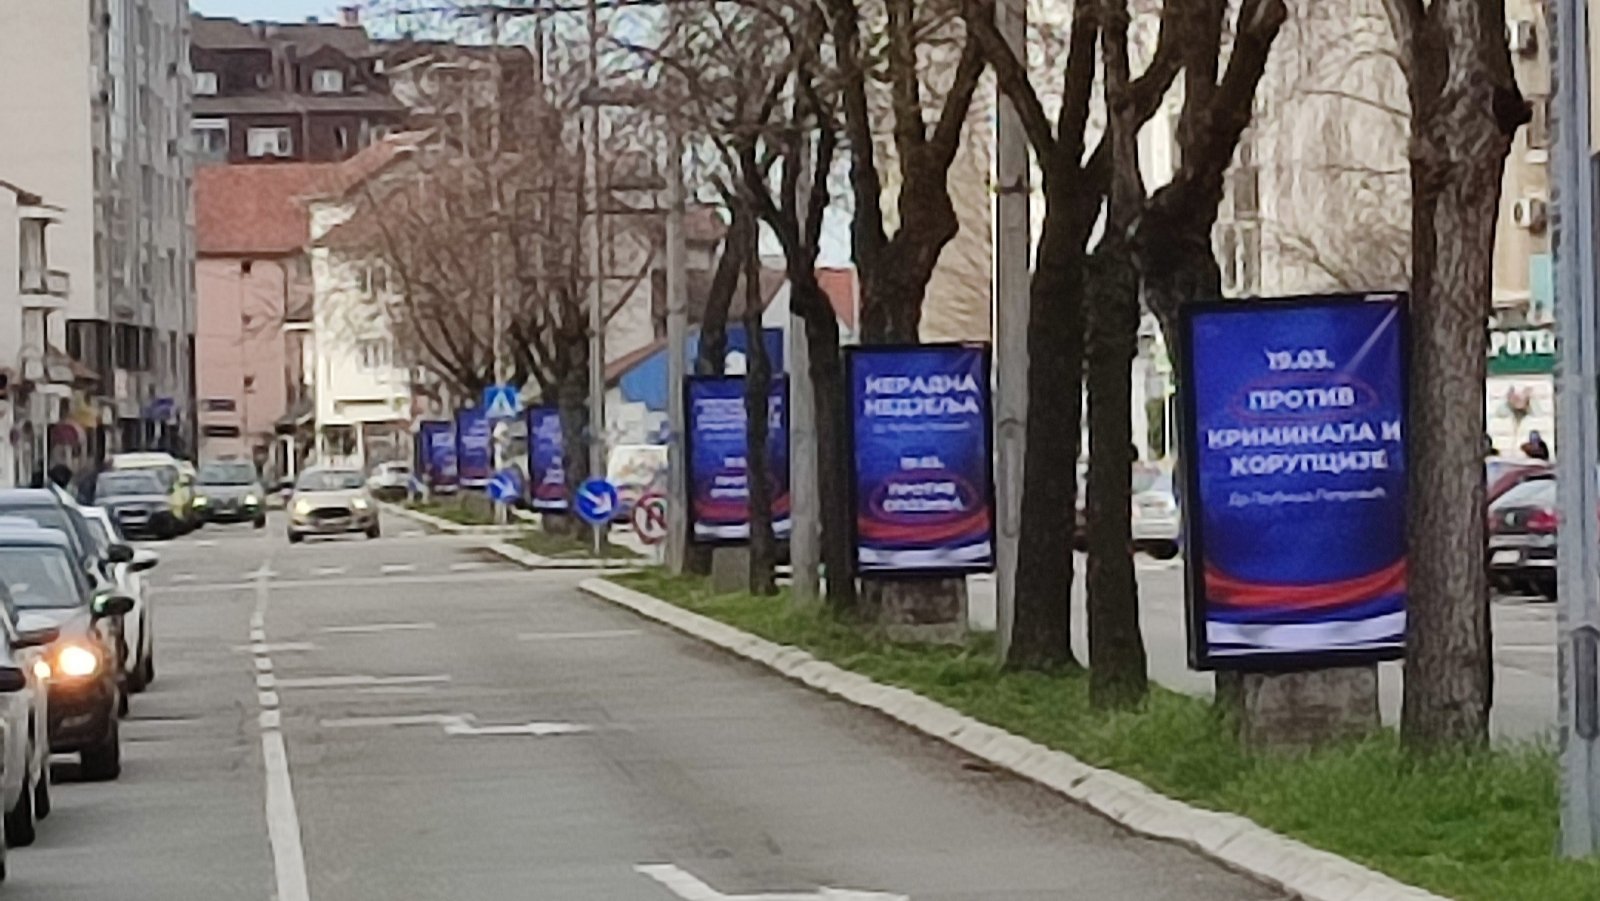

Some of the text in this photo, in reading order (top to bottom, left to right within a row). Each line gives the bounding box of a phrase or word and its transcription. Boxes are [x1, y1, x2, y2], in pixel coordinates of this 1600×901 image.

[1267, 349, 1335, 369] 19.03.
[865, 374, 978, 394] НЕРАДНА
[1249, 386, 1355, 410] ПРОТИВ
[1208, 420, 1401, 449] КРИМИНАЛА И
[1230, 449, 1389, 476] КОРУПЦИЈЕ
